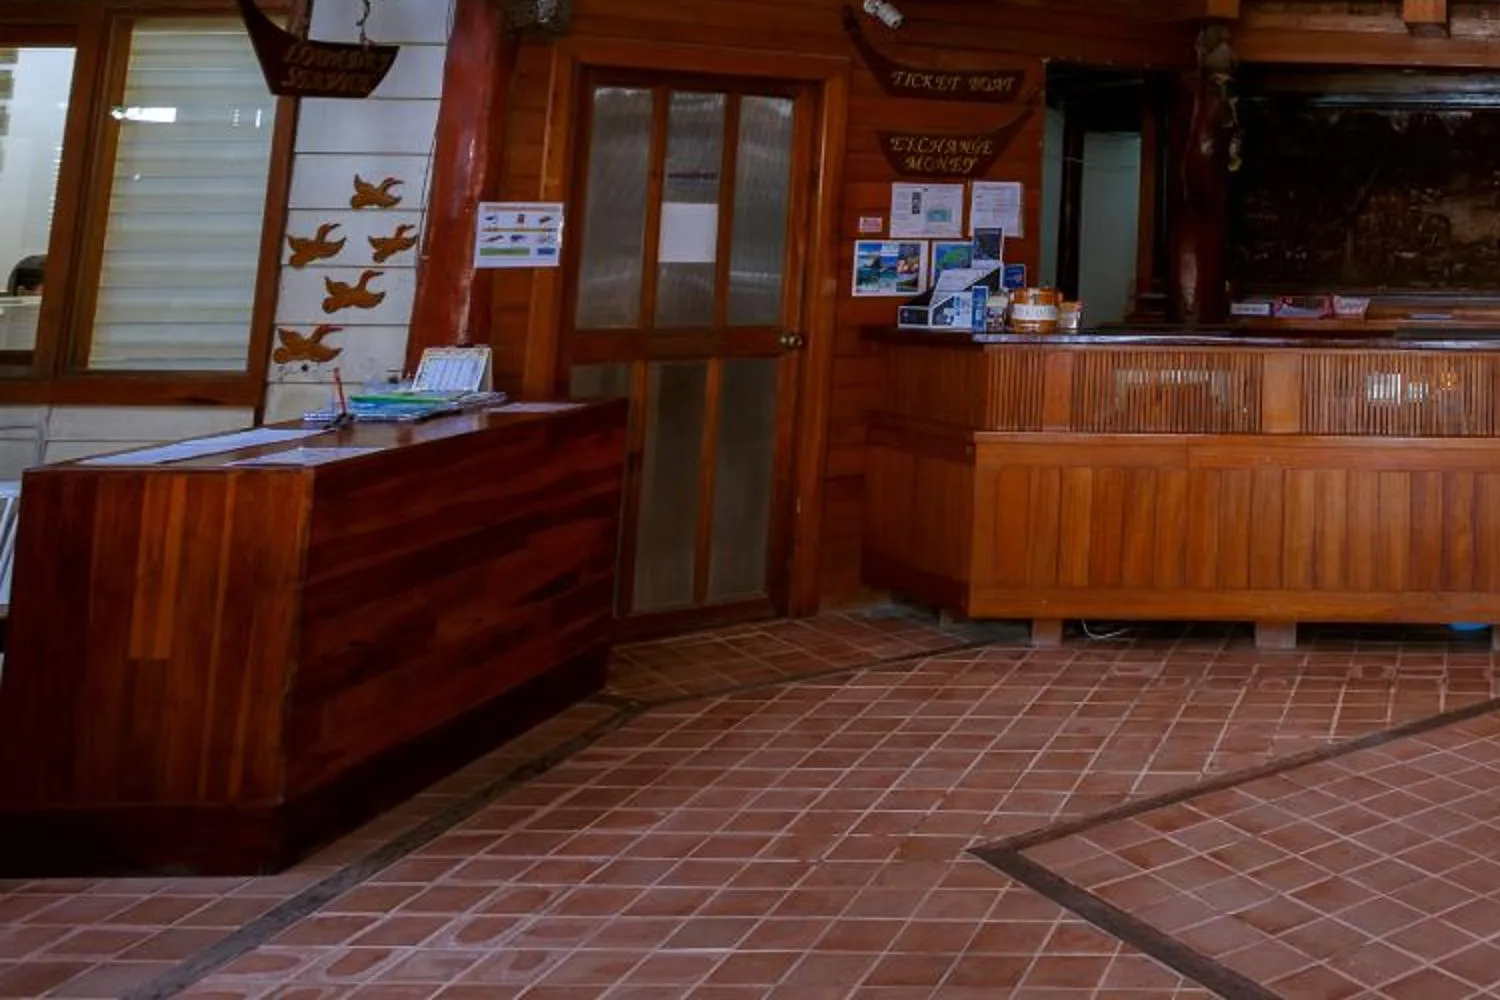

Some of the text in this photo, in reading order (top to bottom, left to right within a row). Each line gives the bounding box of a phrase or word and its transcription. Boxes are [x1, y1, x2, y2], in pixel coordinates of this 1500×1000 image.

[890, 71, 1016, 93] TICKET BOAT
[889, 135, 994, 155] EXCHANGE
[903, 154, 978, 174] MONEY
